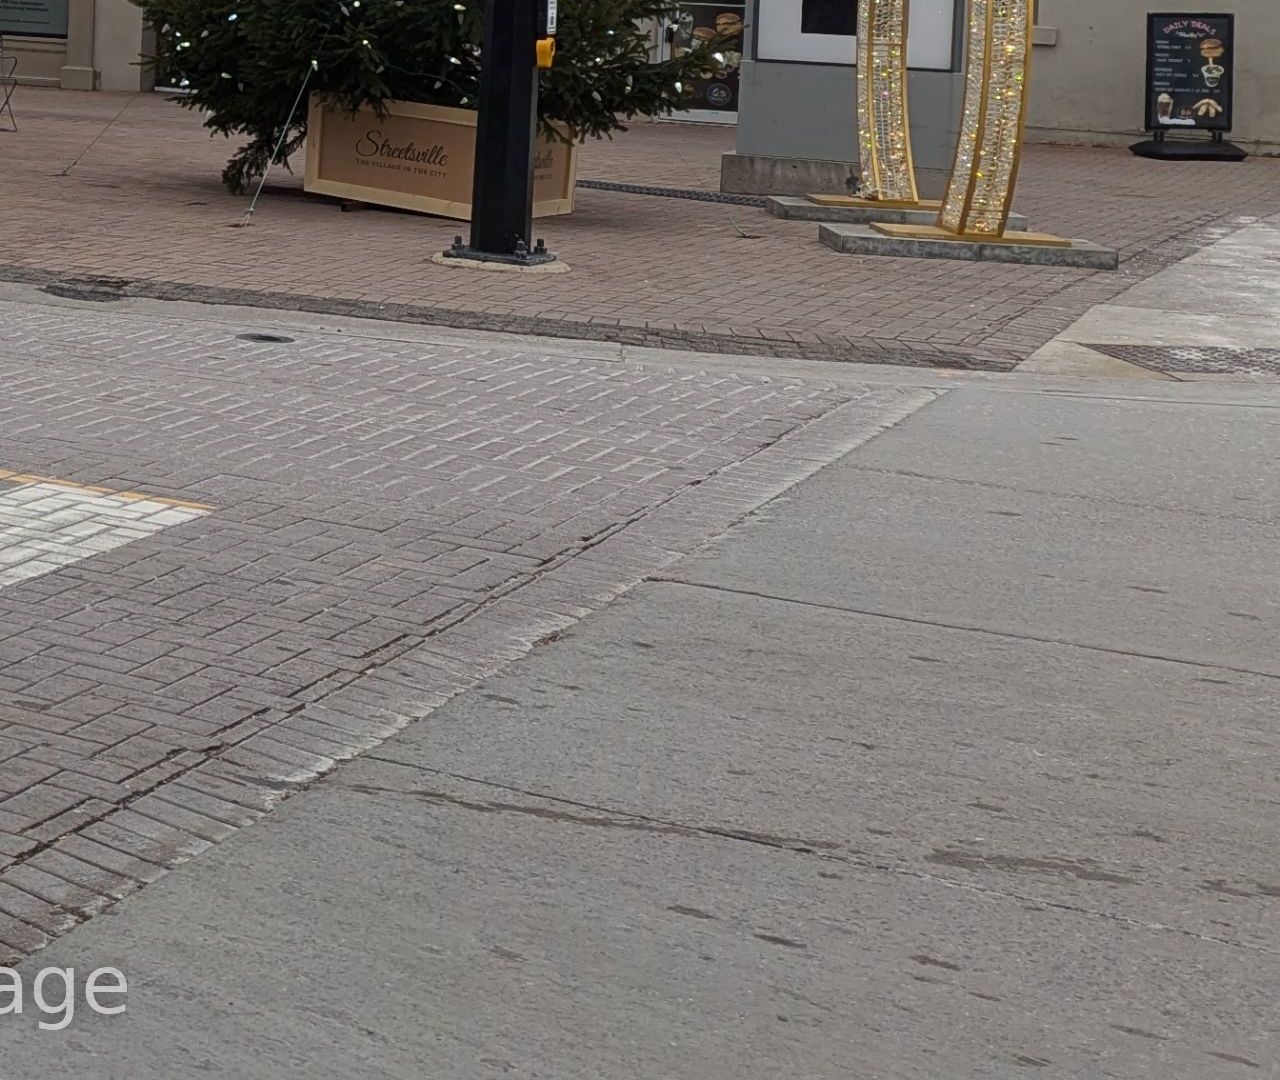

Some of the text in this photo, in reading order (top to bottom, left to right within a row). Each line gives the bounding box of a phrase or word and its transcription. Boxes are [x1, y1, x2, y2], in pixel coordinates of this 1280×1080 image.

[1163, 20, 1217, 35] DAILY DEALS
[355, 130, 448, 167] Streetsville
[372, 161, 401, 170] VILLAGE
